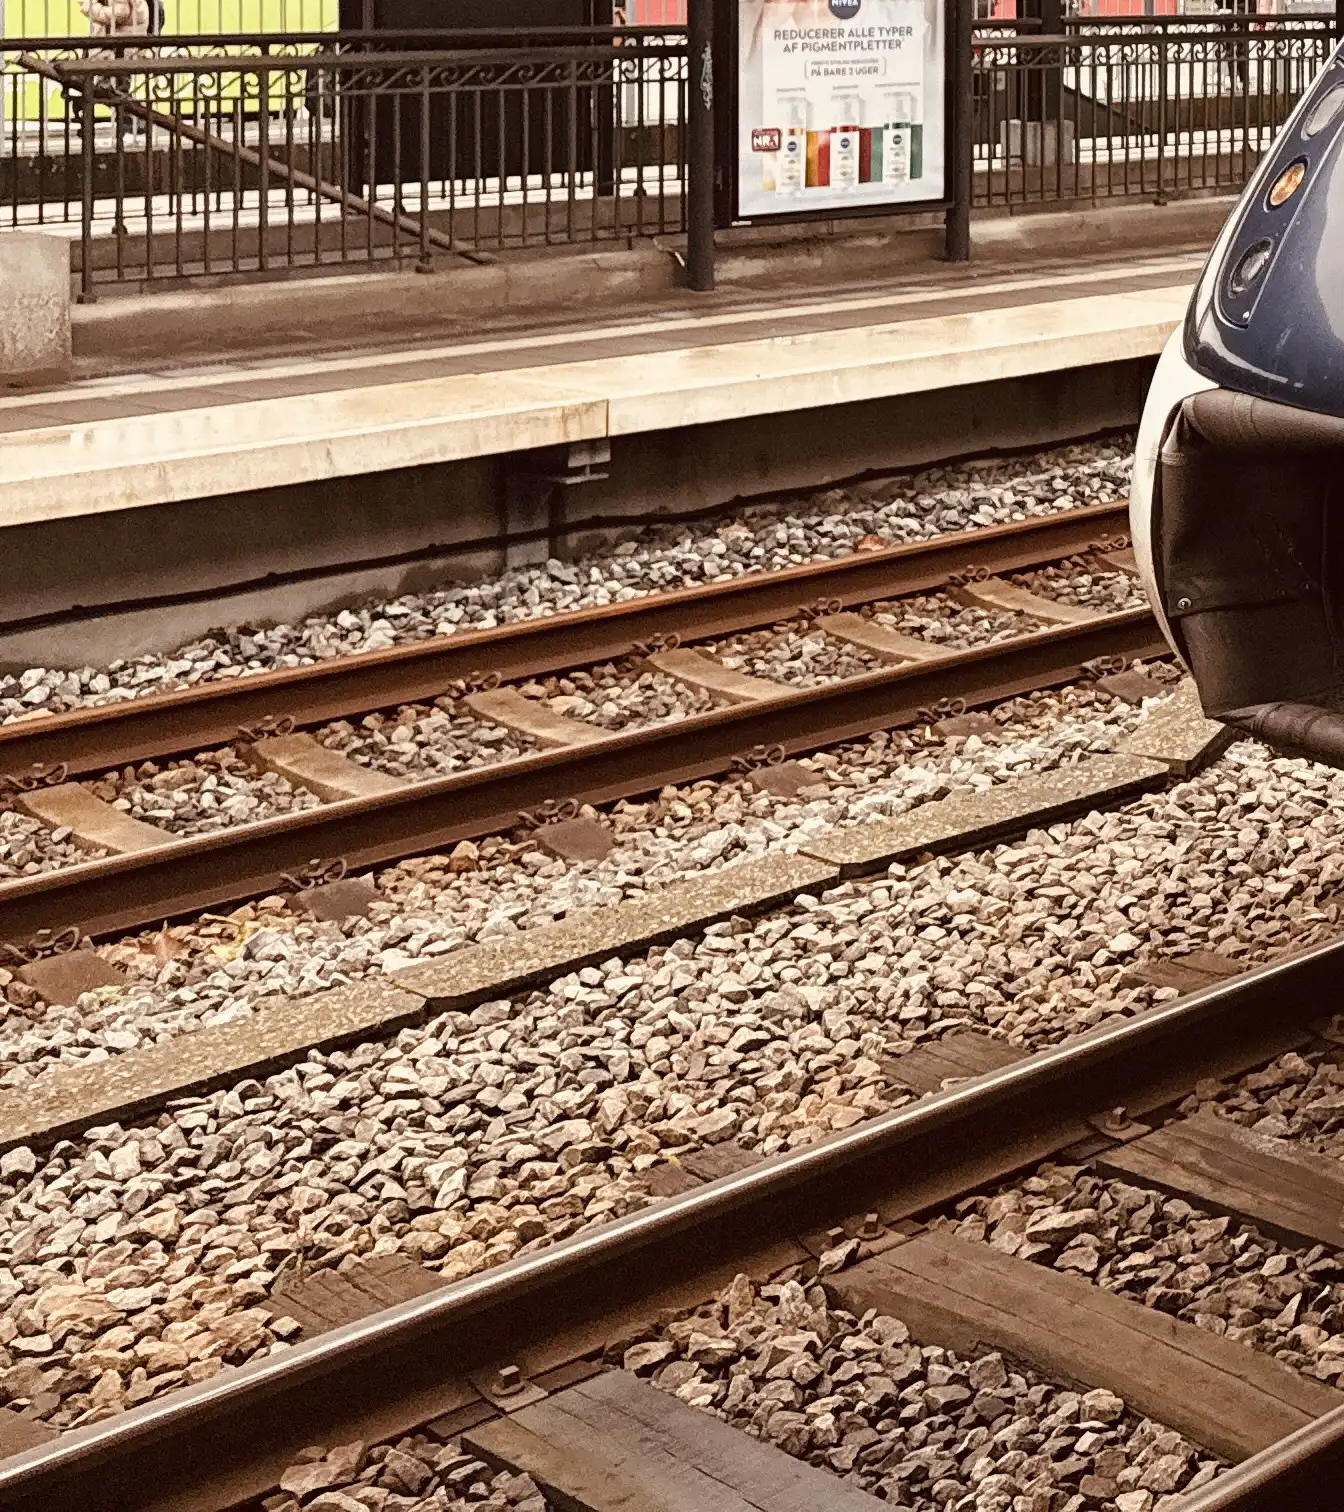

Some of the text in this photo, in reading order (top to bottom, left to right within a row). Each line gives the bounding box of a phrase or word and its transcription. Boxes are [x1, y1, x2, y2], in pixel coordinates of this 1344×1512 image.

[774, 25, 913, 42] REDUCERER ALLE TYPER
[783, 43, 799, 54] AF
[823, 67, 846, 76] BARE
[855, 66, 879, 75] UGER
